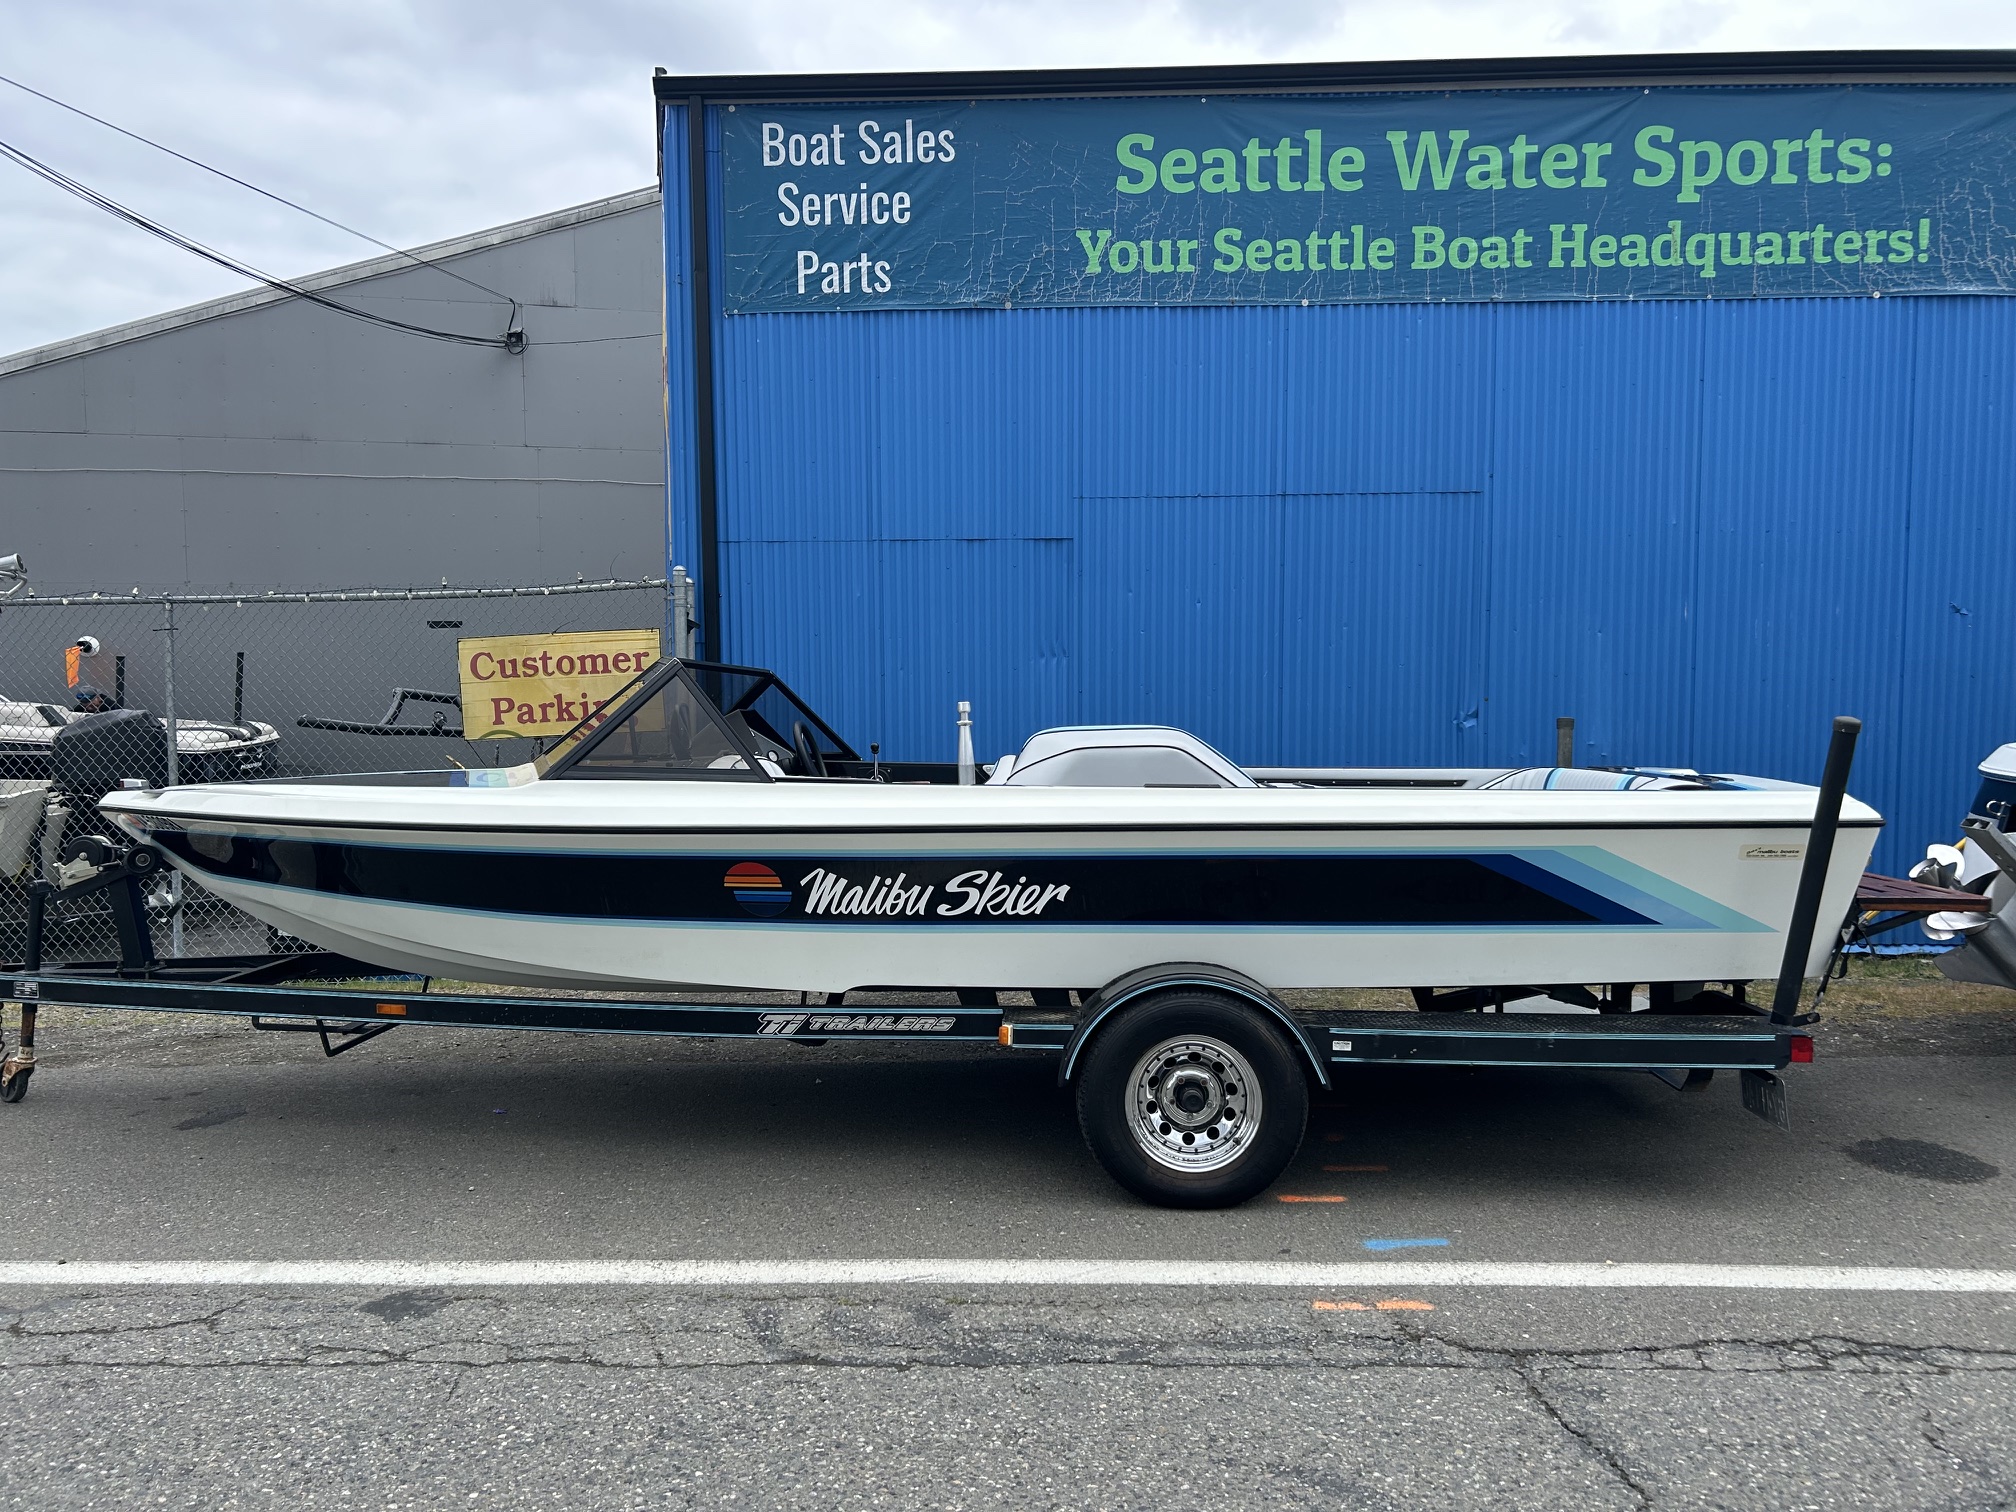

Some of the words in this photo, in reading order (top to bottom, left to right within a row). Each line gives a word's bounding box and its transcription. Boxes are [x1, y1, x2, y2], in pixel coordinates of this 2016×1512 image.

[762, 122, 845, 167] Boat
[858, 119, 956, 165] Sales
[1115, 129, 1366, 194] Seattle
[1385, 129, 1612, 191] Water
[1632, 125, 1893, 203] Sports:
[777, 182, 911, 227] Service
[1075, 229, 1198, 274] Your
[1213, 225, 1395, 273] Seattle
[1411, 225, 1532, 270] Boat
[1548, 218, 1930, 278] Headquarters!
[797, 250, 892, 294] Parts
[469, 650, 650, 681] Customer
[491, 692, 639, 728] Parki
[800, 867, 935, 917] Malibu
[936, 869, 1071, 917] Skier
[809, 1015, 956, 1031] TRAILERS
